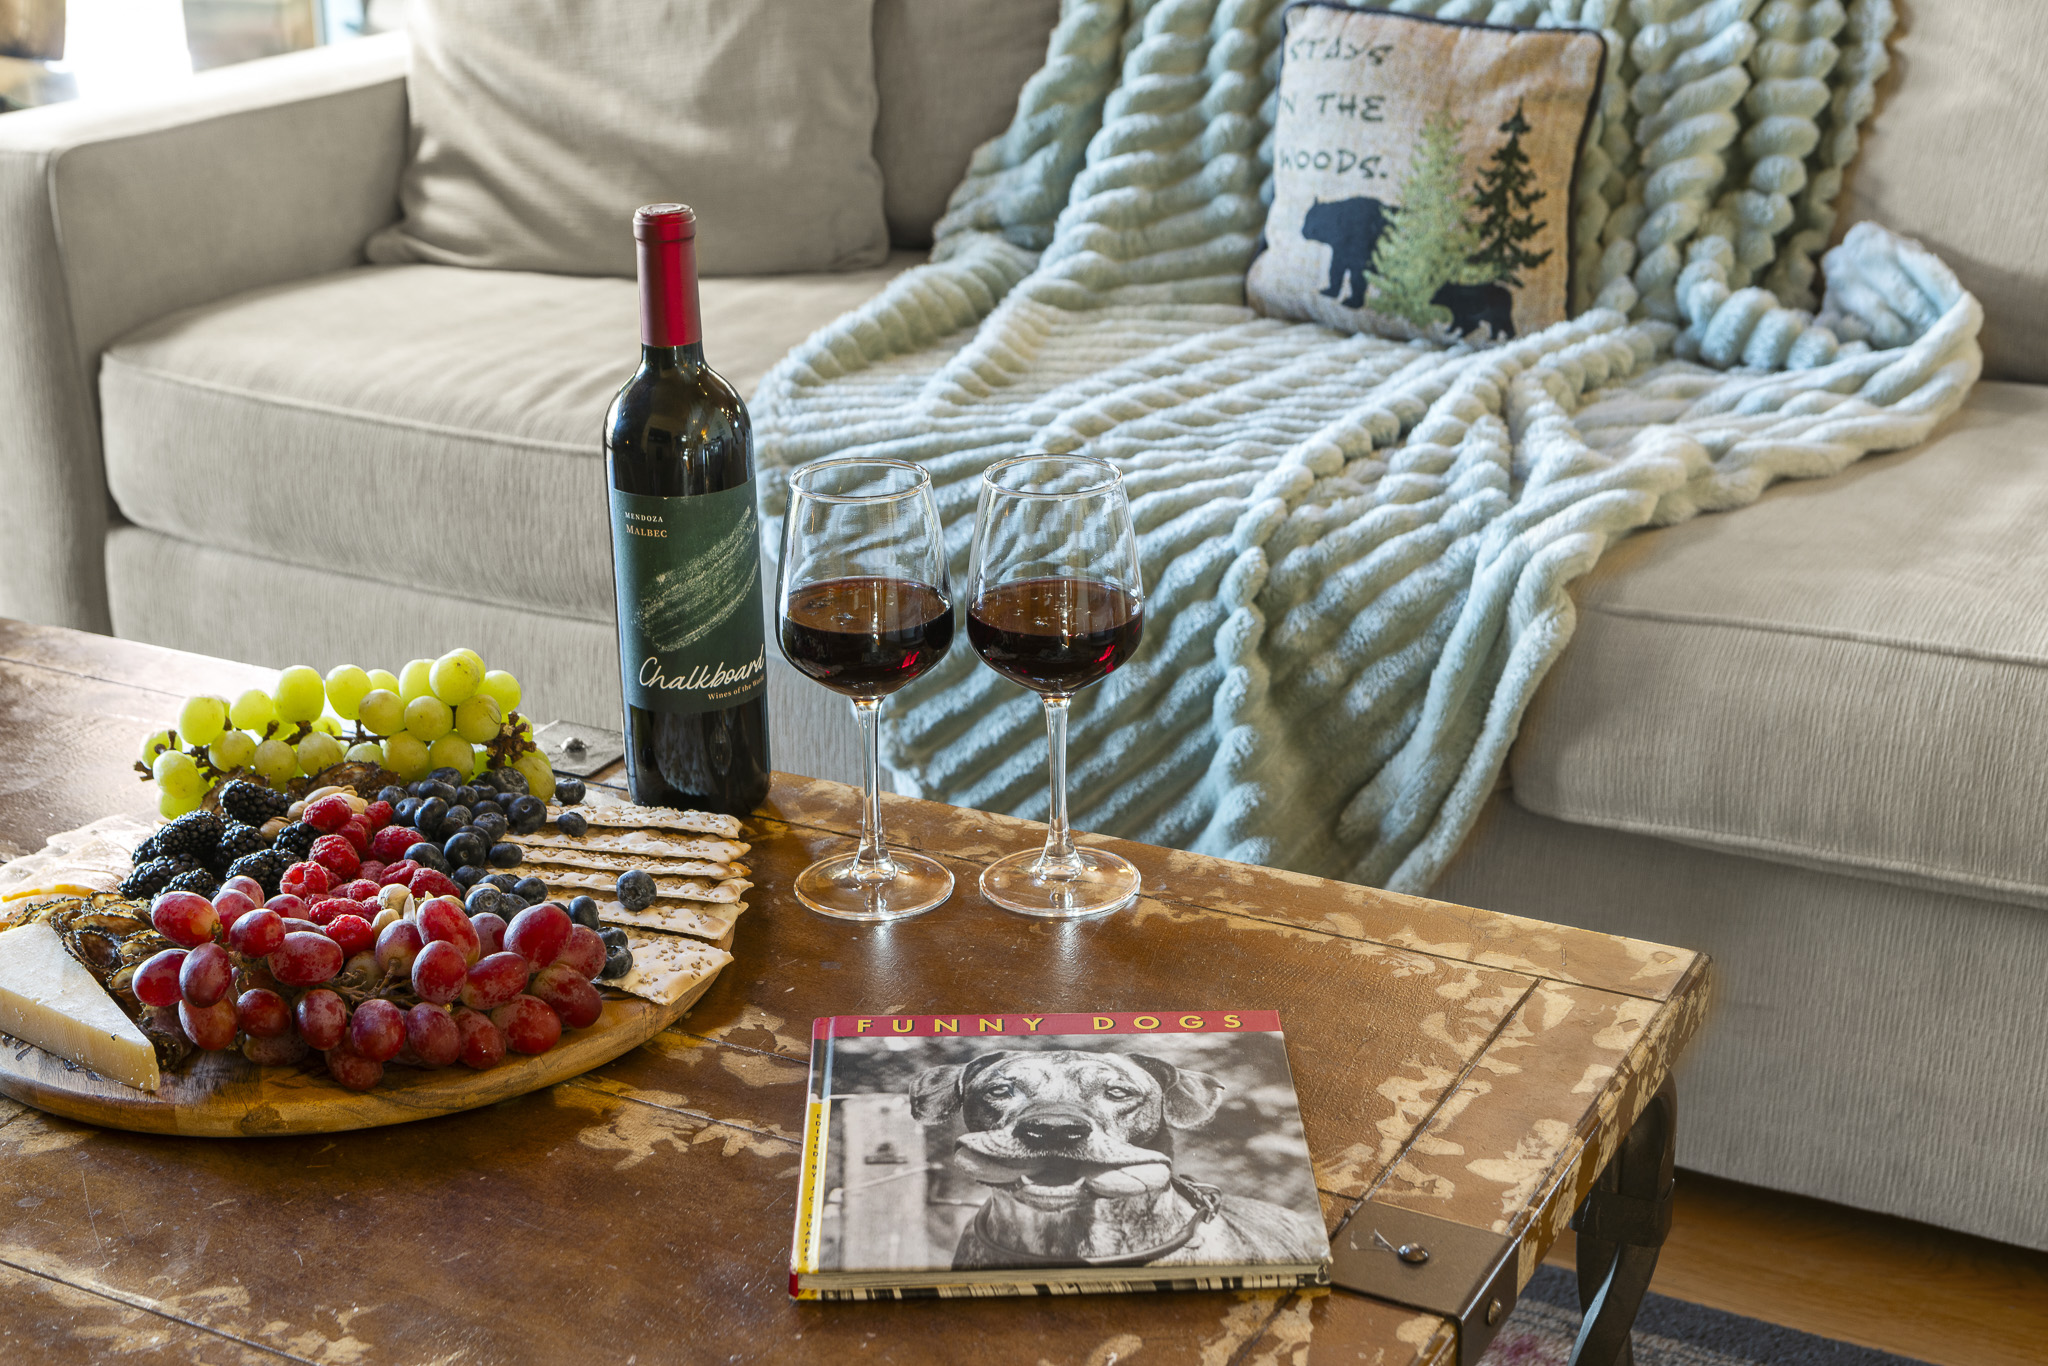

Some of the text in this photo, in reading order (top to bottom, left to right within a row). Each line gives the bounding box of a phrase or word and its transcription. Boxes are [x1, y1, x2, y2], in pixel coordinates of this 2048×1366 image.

[1316, 92, 1386, 122] THE
[624, 511, 664, 523] MENDOZA
[625, 523, 668, 538] MALBEC
[639, 643, 765, 690] Chalkboard
[707, 683, 752, 701] Wines of the
[856, 1013, 1249, 1034] FUNNY DOGS
[812, 1113, 822, 1157] EDITED
